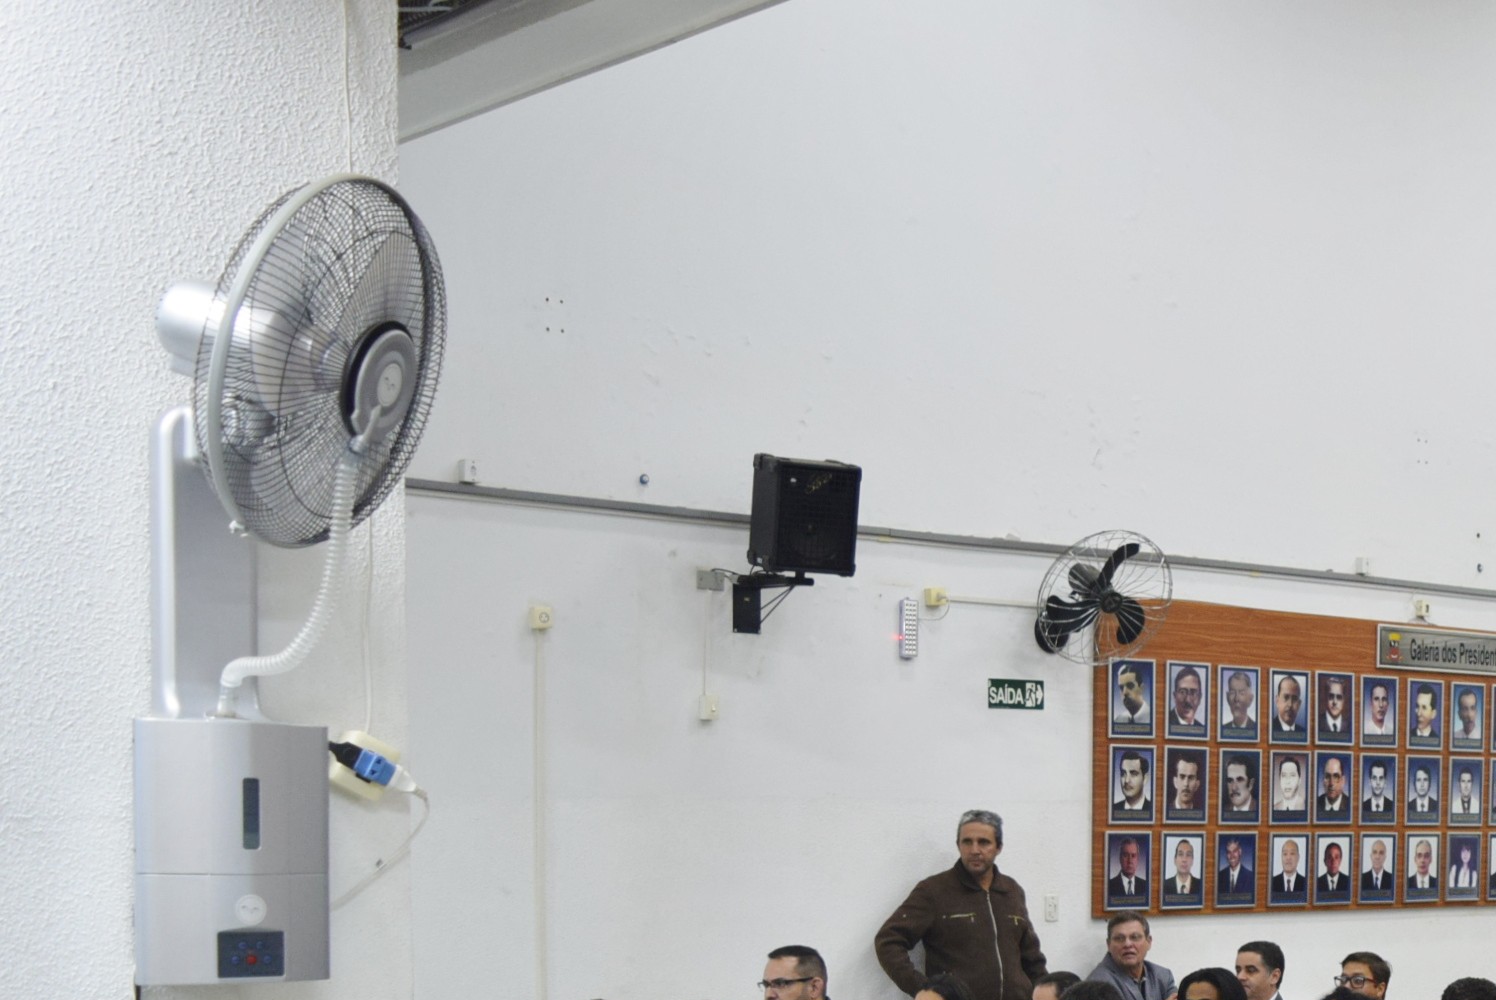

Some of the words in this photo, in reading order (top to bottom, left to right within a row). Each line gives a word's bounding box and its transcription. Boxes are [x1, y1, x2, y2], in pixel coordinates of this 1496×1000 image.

[1410, 638, 1440, 661] Galeria
[1441, 641, 1457, 663] dos
[988, 683, 1024, 704] SAÍDA
